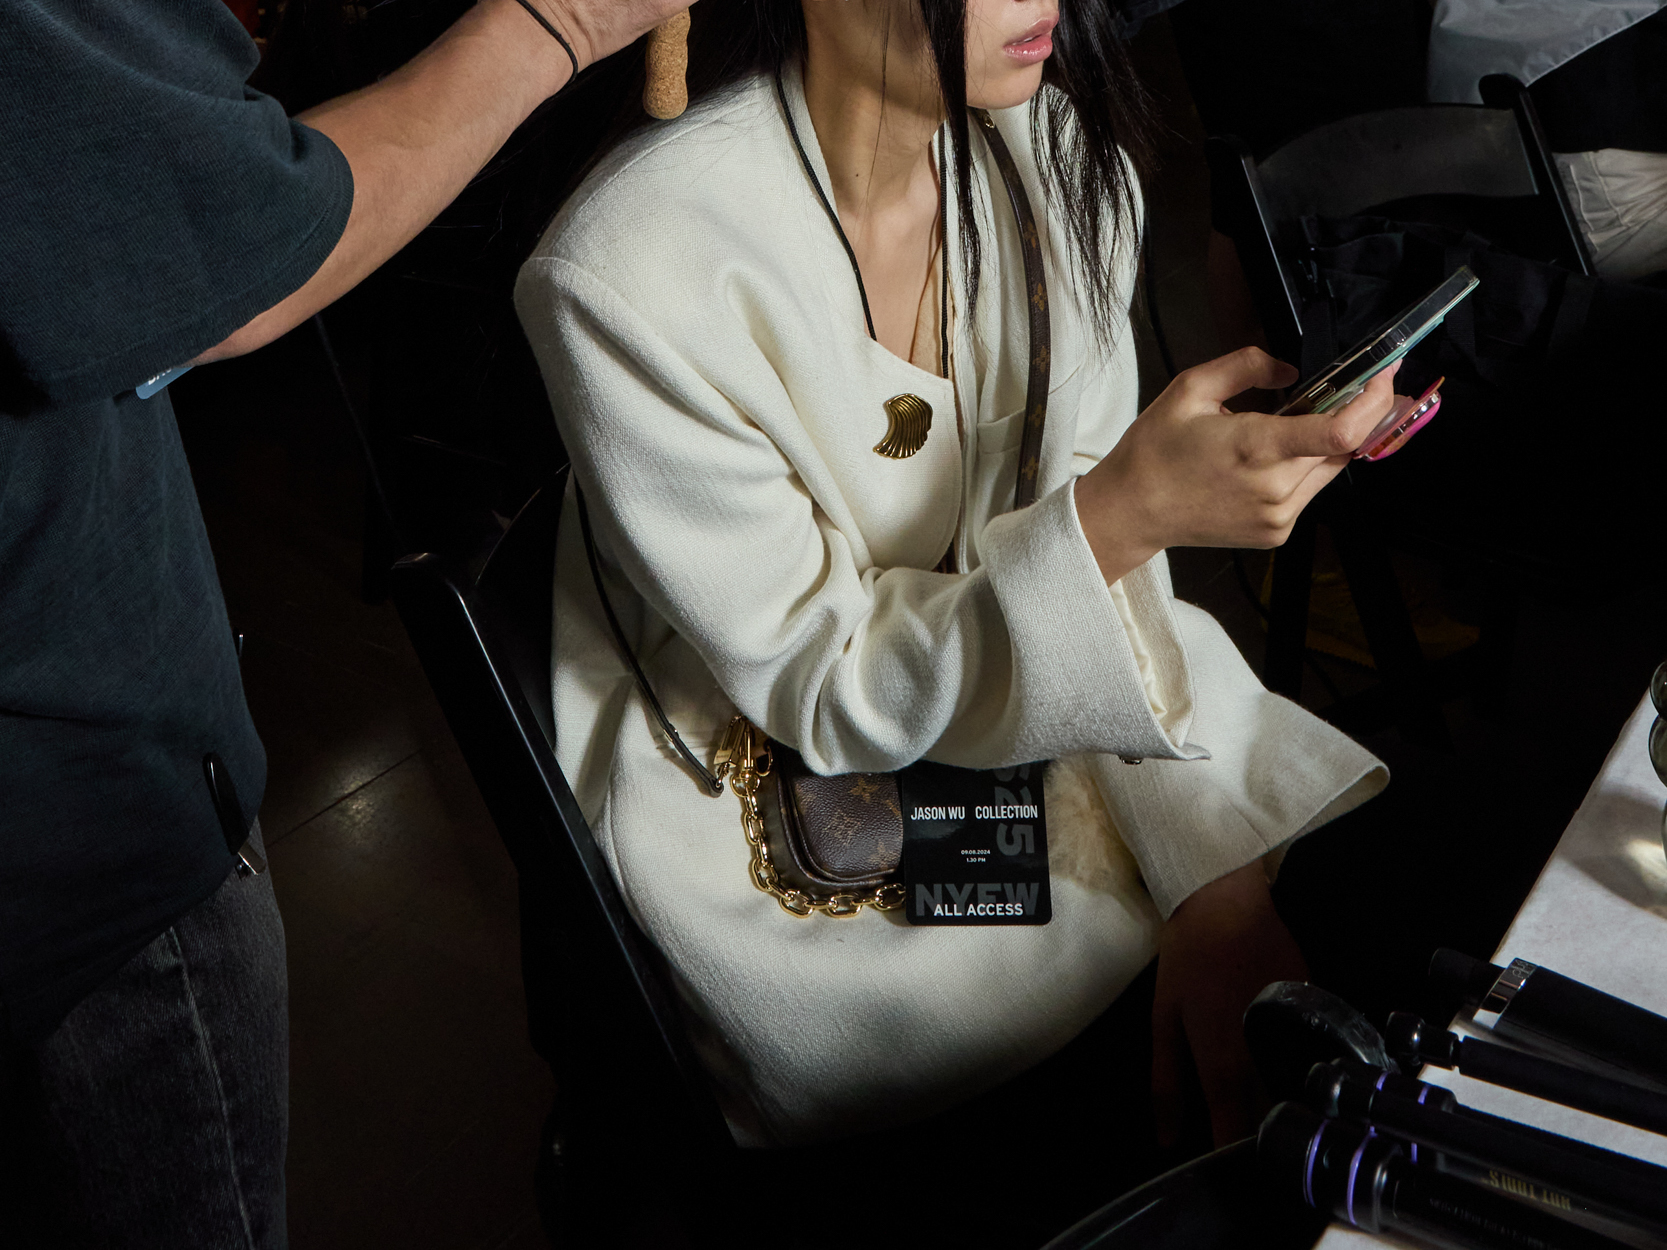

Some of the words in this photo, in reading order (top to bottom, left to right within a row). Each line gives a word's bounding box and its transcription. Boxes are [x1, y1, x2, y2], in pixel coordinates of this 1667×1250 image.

[911, 806, 946, 820] JASON
[947, 806, 965, 820] WU
[974, 804, 1038, 819] COLLECTION
[914, 882, 1039, 916] NYFW
[933, 903, 962, 916] ALL
[966, 902, 1023, 916] ACCESS
